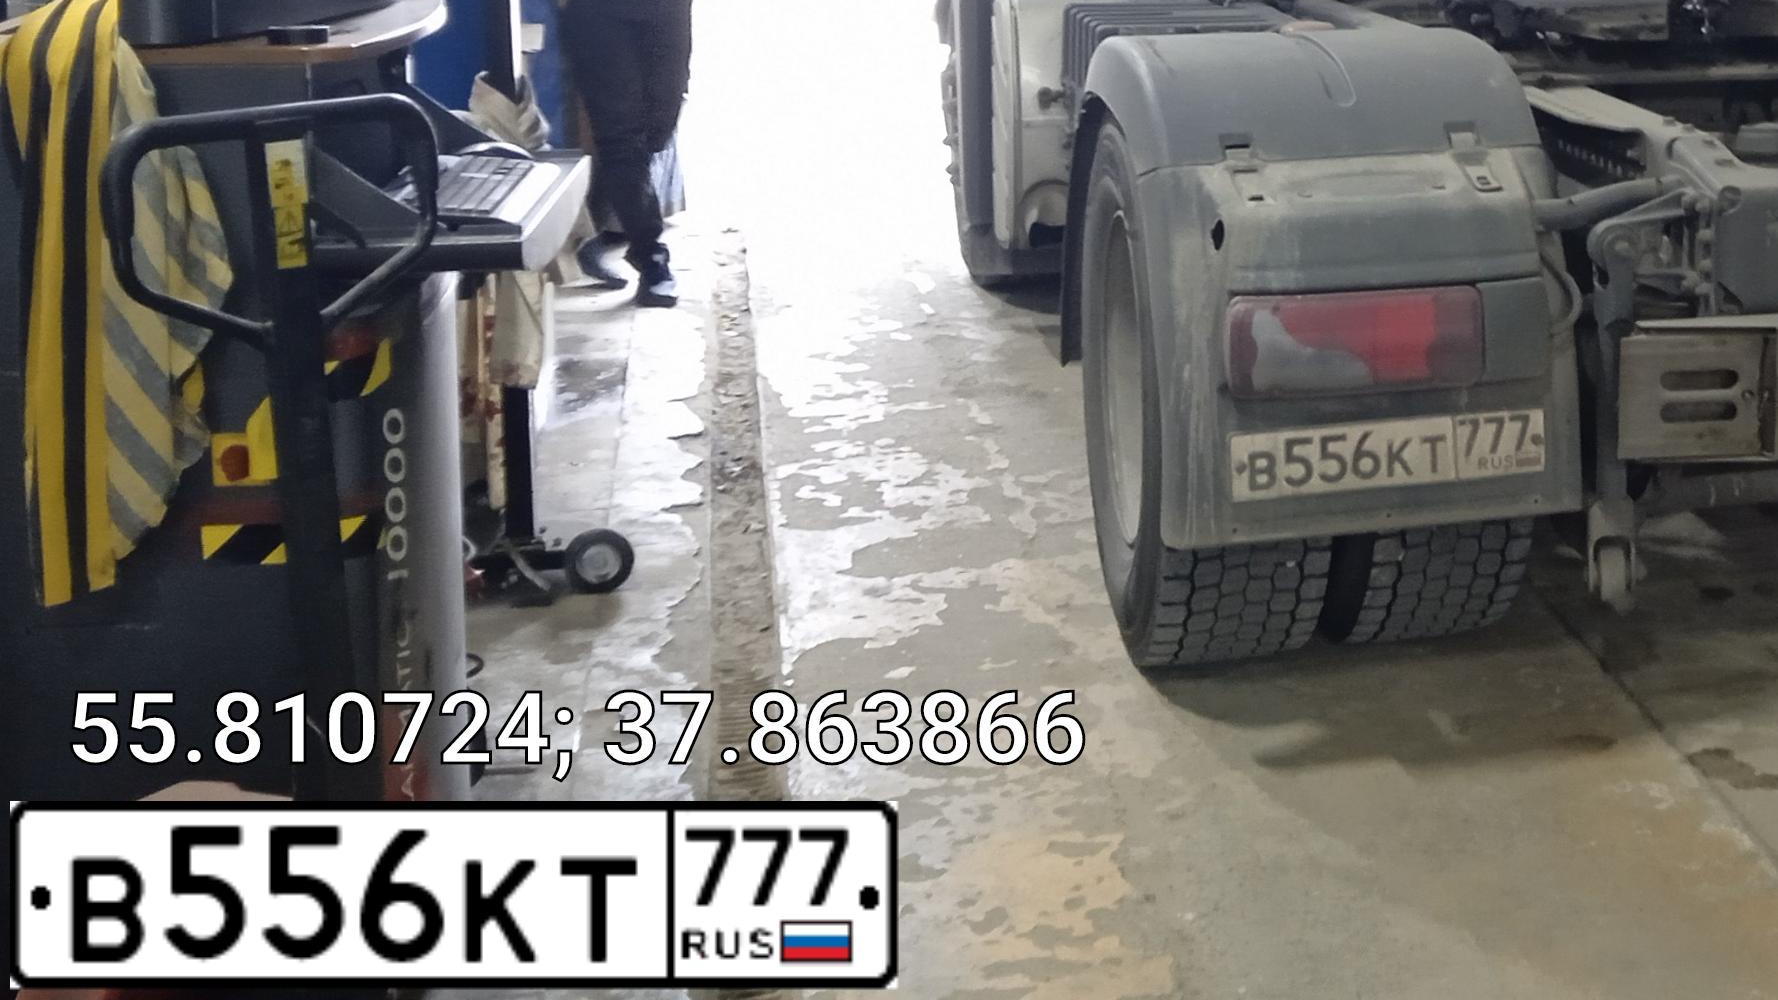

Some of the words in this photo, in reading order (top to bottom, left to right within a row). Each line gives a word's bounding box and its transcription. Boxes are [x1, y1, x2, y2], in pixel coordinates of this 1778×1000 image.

[1458, 414, 1531, 459] 777
[1477, 454, 1513, 470] RUS
[382, 408, 410, 580] 10000
